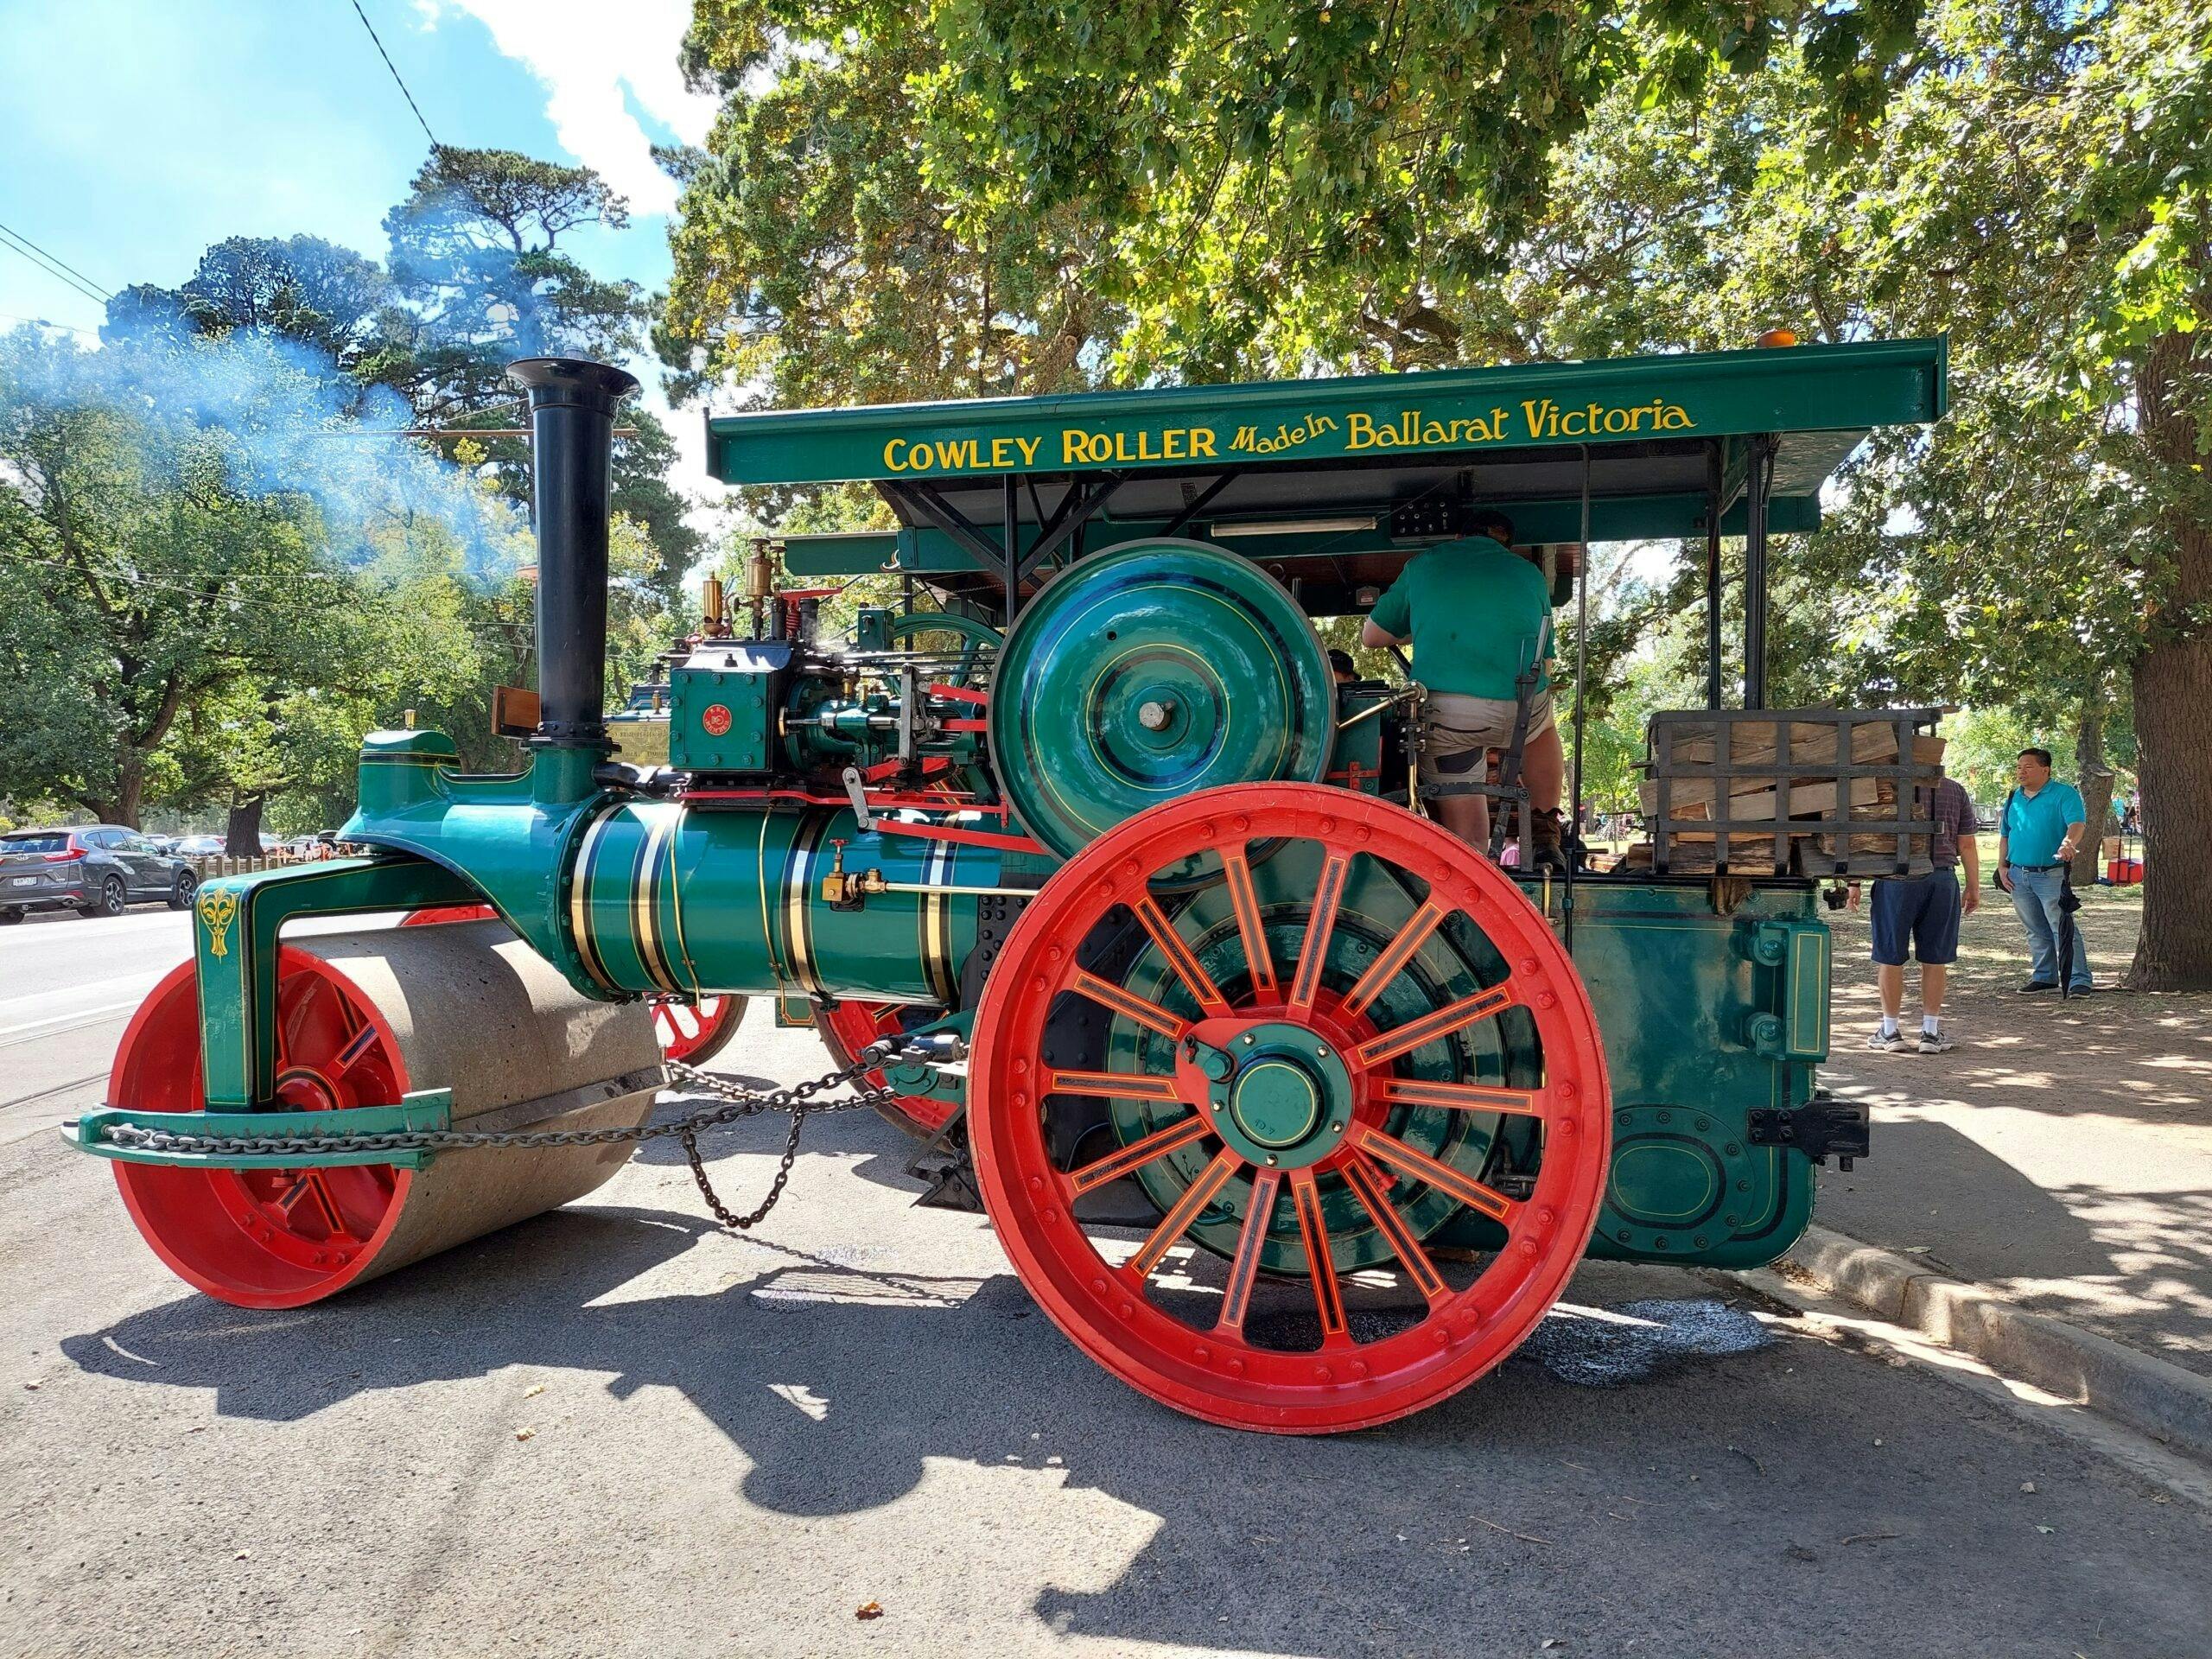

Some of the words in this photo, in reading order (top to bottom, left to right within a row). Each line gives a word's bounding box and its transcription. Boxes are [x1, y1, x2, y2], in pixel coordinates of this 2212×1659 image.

[883, 435, 1042, 472] COWLEY
[1062, 428, 1219, 464] ROLLER
[1344, 407, 1510, 450] Ballarat
[1520, 398, 1699, 438] Victoria
